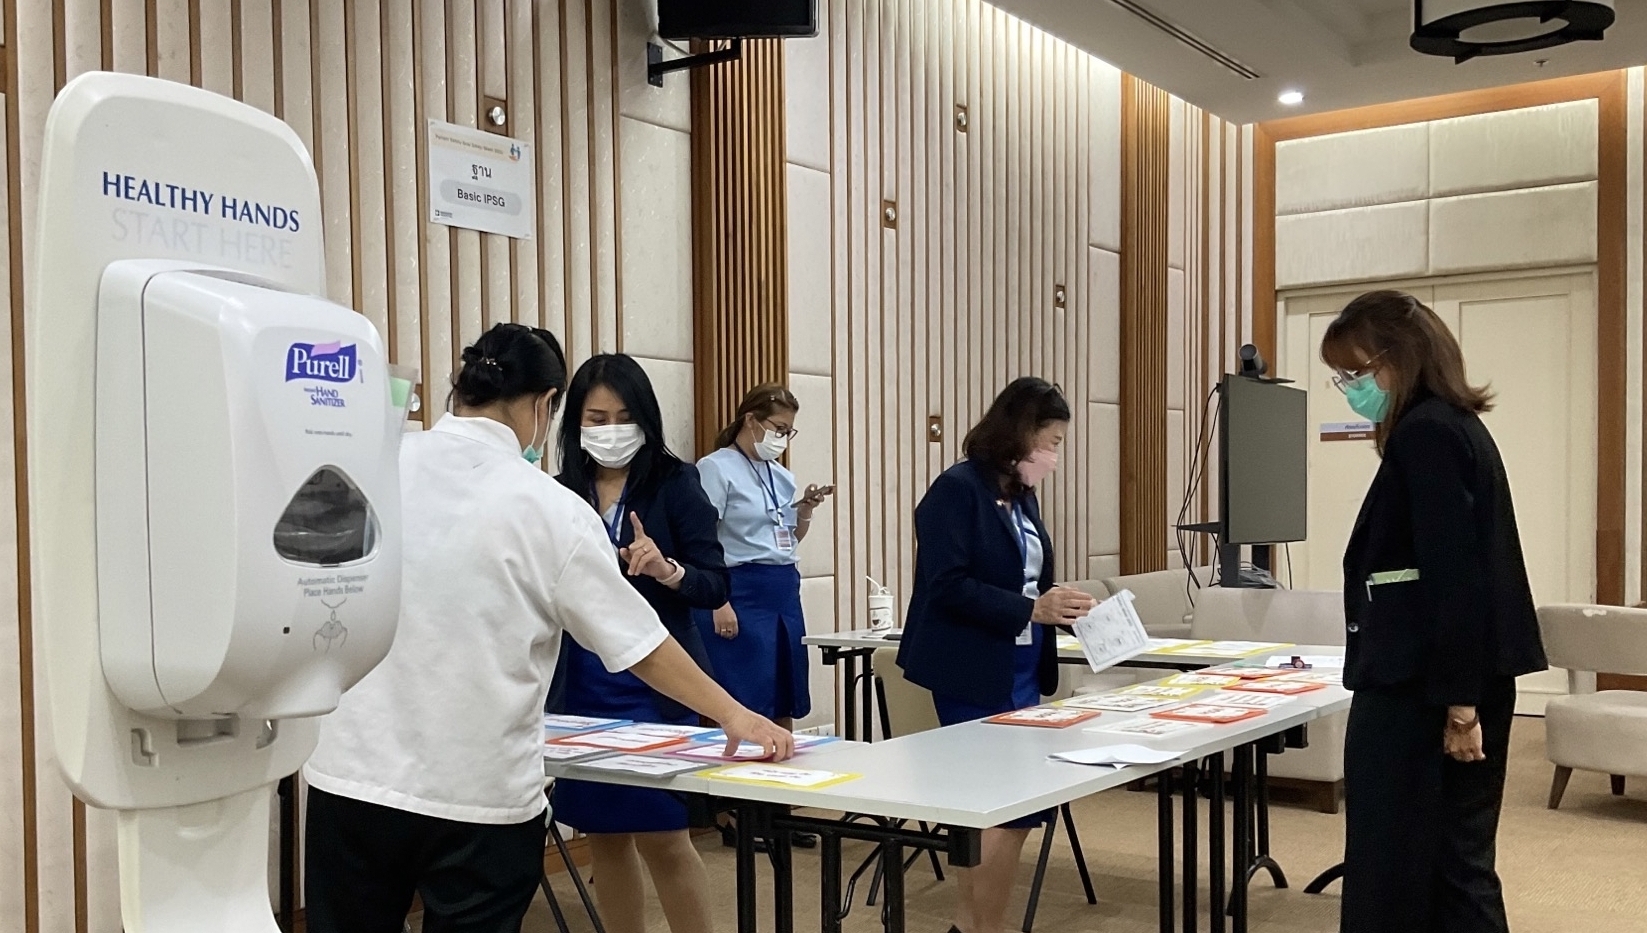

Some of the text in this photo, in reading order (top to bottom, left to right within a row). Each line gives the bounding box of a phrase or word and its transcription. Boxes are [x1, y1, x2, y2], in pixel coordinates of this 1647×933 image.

[471, 164, 492, 181] ฐาน
[102, 171, 300, 232] HEALTHY HANDS
[457, 188, 505, 207] Basic IPSG
[112, 207, 293, 269] START HERE
[292, 347, 350, 379] Purell
[316, 386, 339, 398] HAND
[310, 394, 346, 408] SANITIZER
[297, 575, 369, 586] Automatic Dispenser
[303, 585, 364, 596] Place Hands Below
